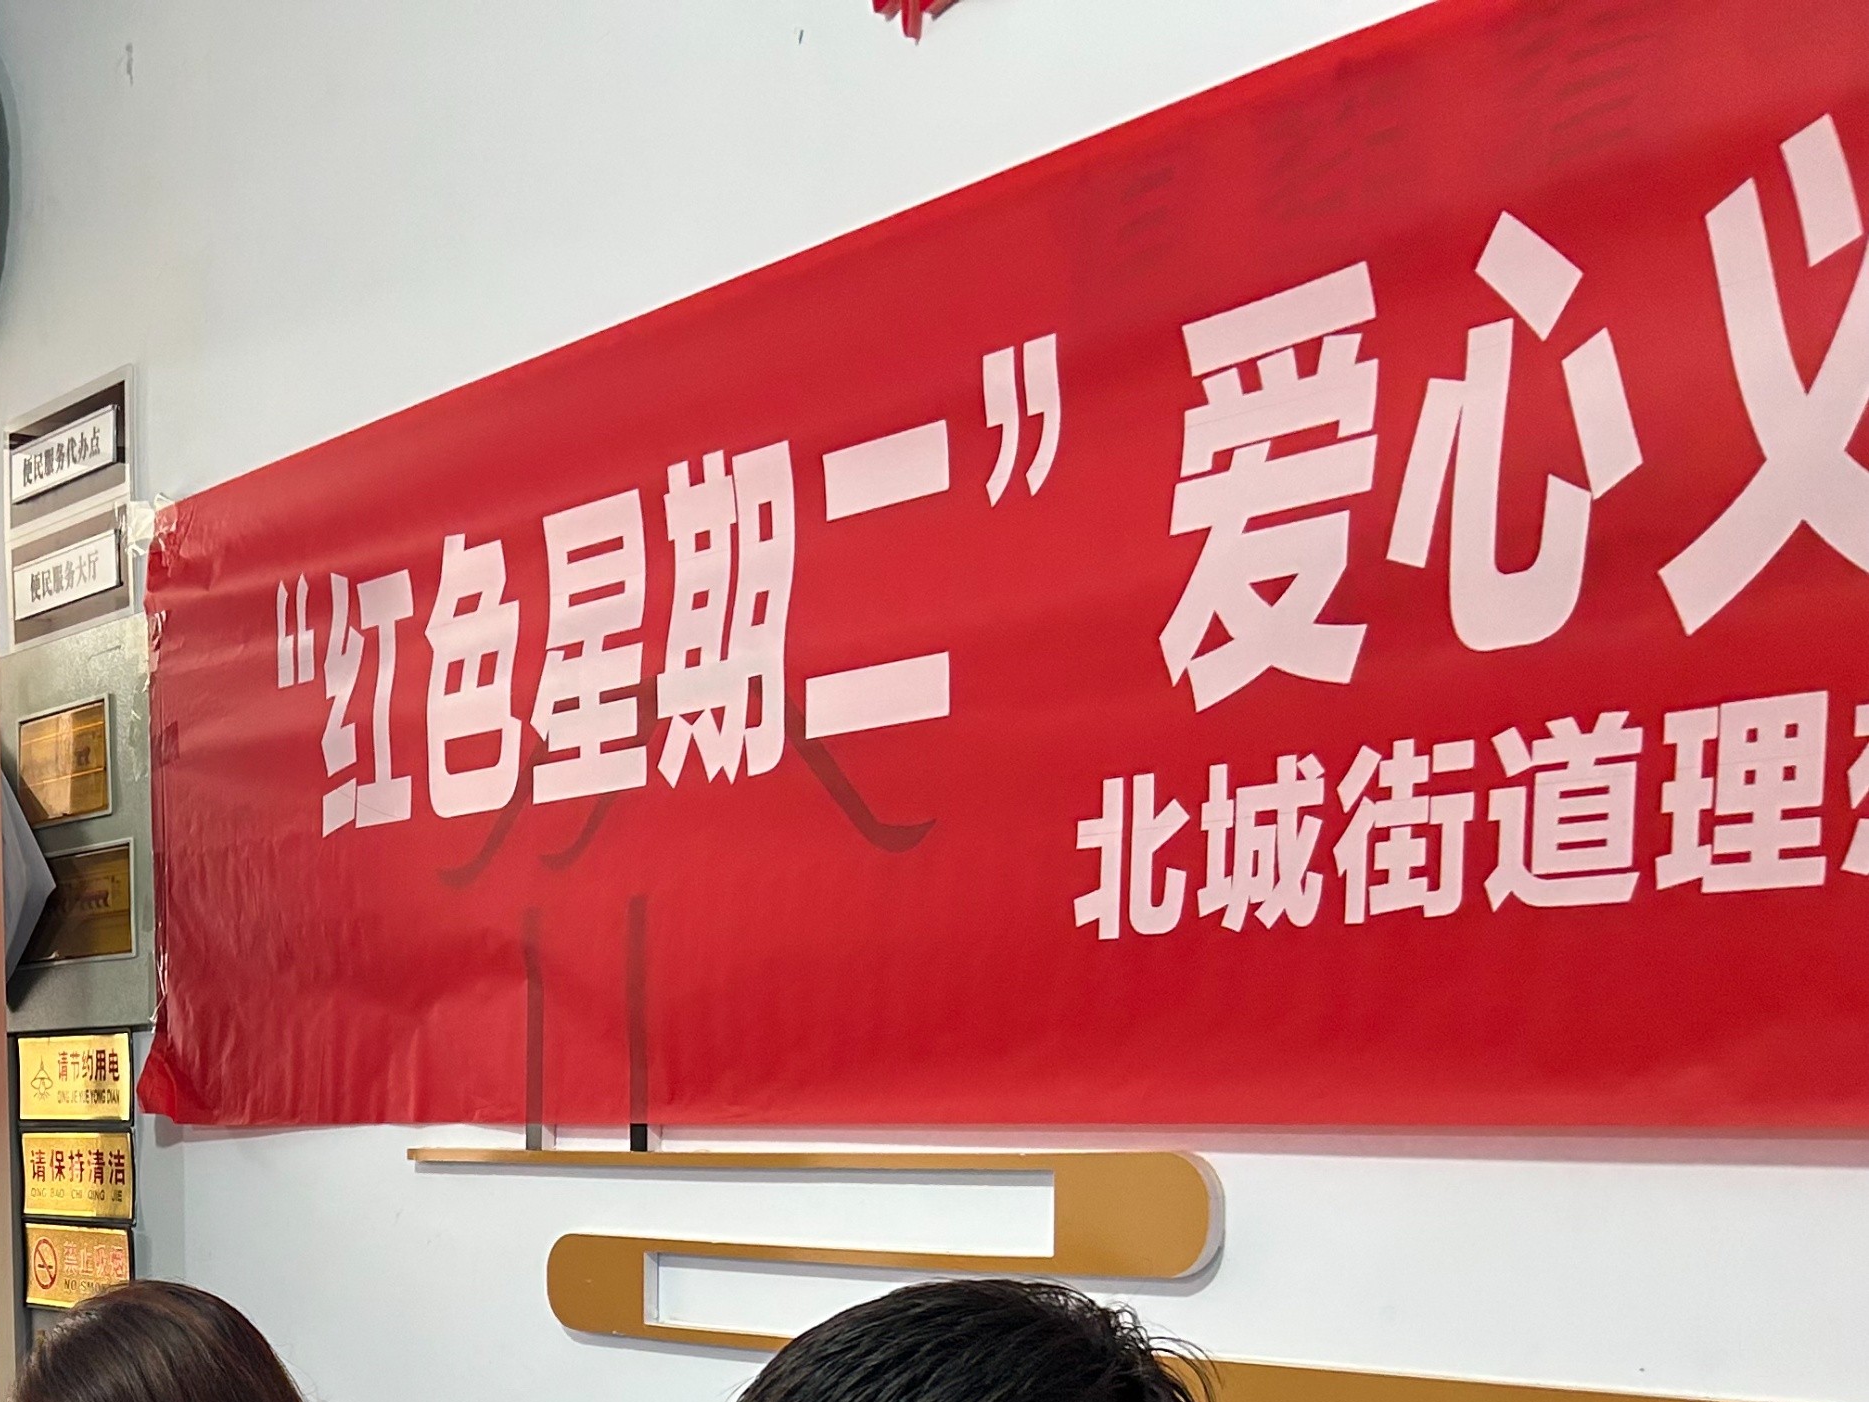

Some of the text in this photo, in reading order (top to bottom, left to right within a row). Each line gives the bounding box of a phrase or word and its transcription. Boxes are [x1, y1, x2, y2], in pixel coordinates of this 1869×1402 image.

[23, 426, 100, 487] 便民服务代办点
[30, 550, 98, 602] 便民服务大厅
[1073, 689, 1869, 940] 北城街道理
[57, 1048, 120, 1082] 请节约用电
[30, 1149, 125, 1185] 请保持清洁
[63, 1241, 125, 1279] 禁止吸烟
[64, 1279, 77, 1290] NO
